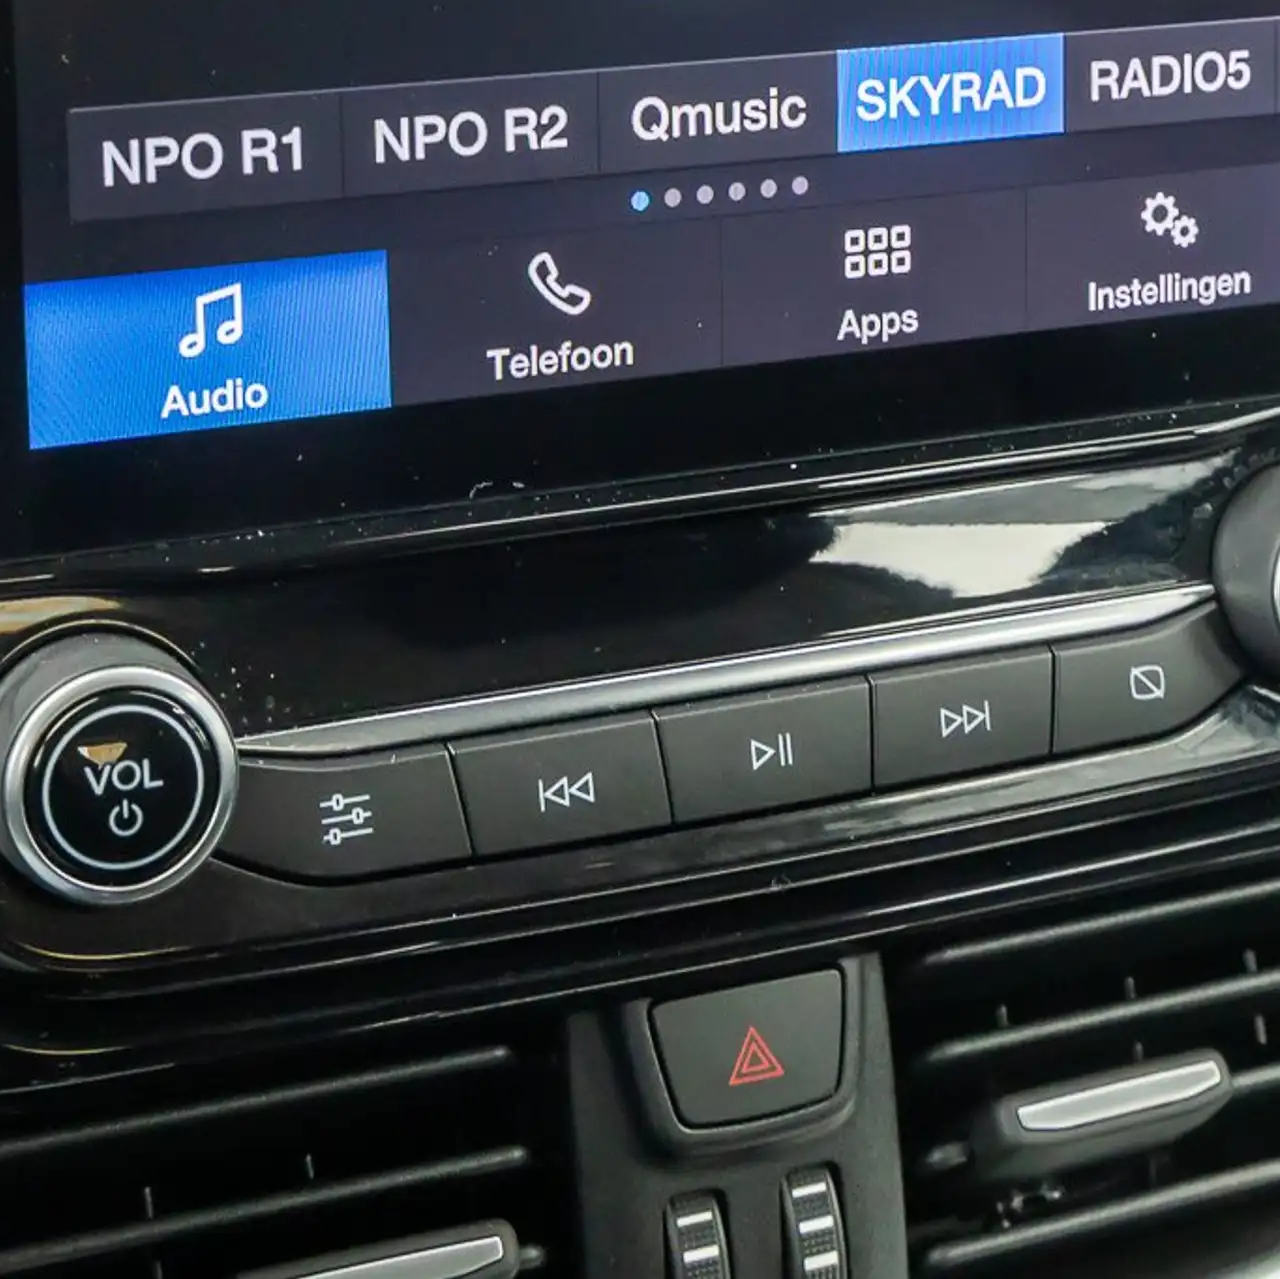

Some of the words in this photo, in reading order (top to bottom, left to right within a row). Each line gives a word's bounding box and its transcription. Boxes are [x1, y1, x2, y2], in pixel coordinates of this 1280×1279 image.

[856, 66, 1047, 122] SKYRAD
[1090, 49, 1251, 102] RADIO5
[373, 110, 487, 164] NPO
[504, 105, 569, 154] R2
[631, 85, 807, 142] Qmusic
[102, 133, 223, 187] NPO
[241, 126, 303, 175] R1
[1088, 268, 1251, 312] Instellingen
[837, 308, 919, 345] Apps
[486, 340, 634, 382] Telefoon
[161, 377, 268, 420] Audio
[83, 757, 164, 797] VOL
